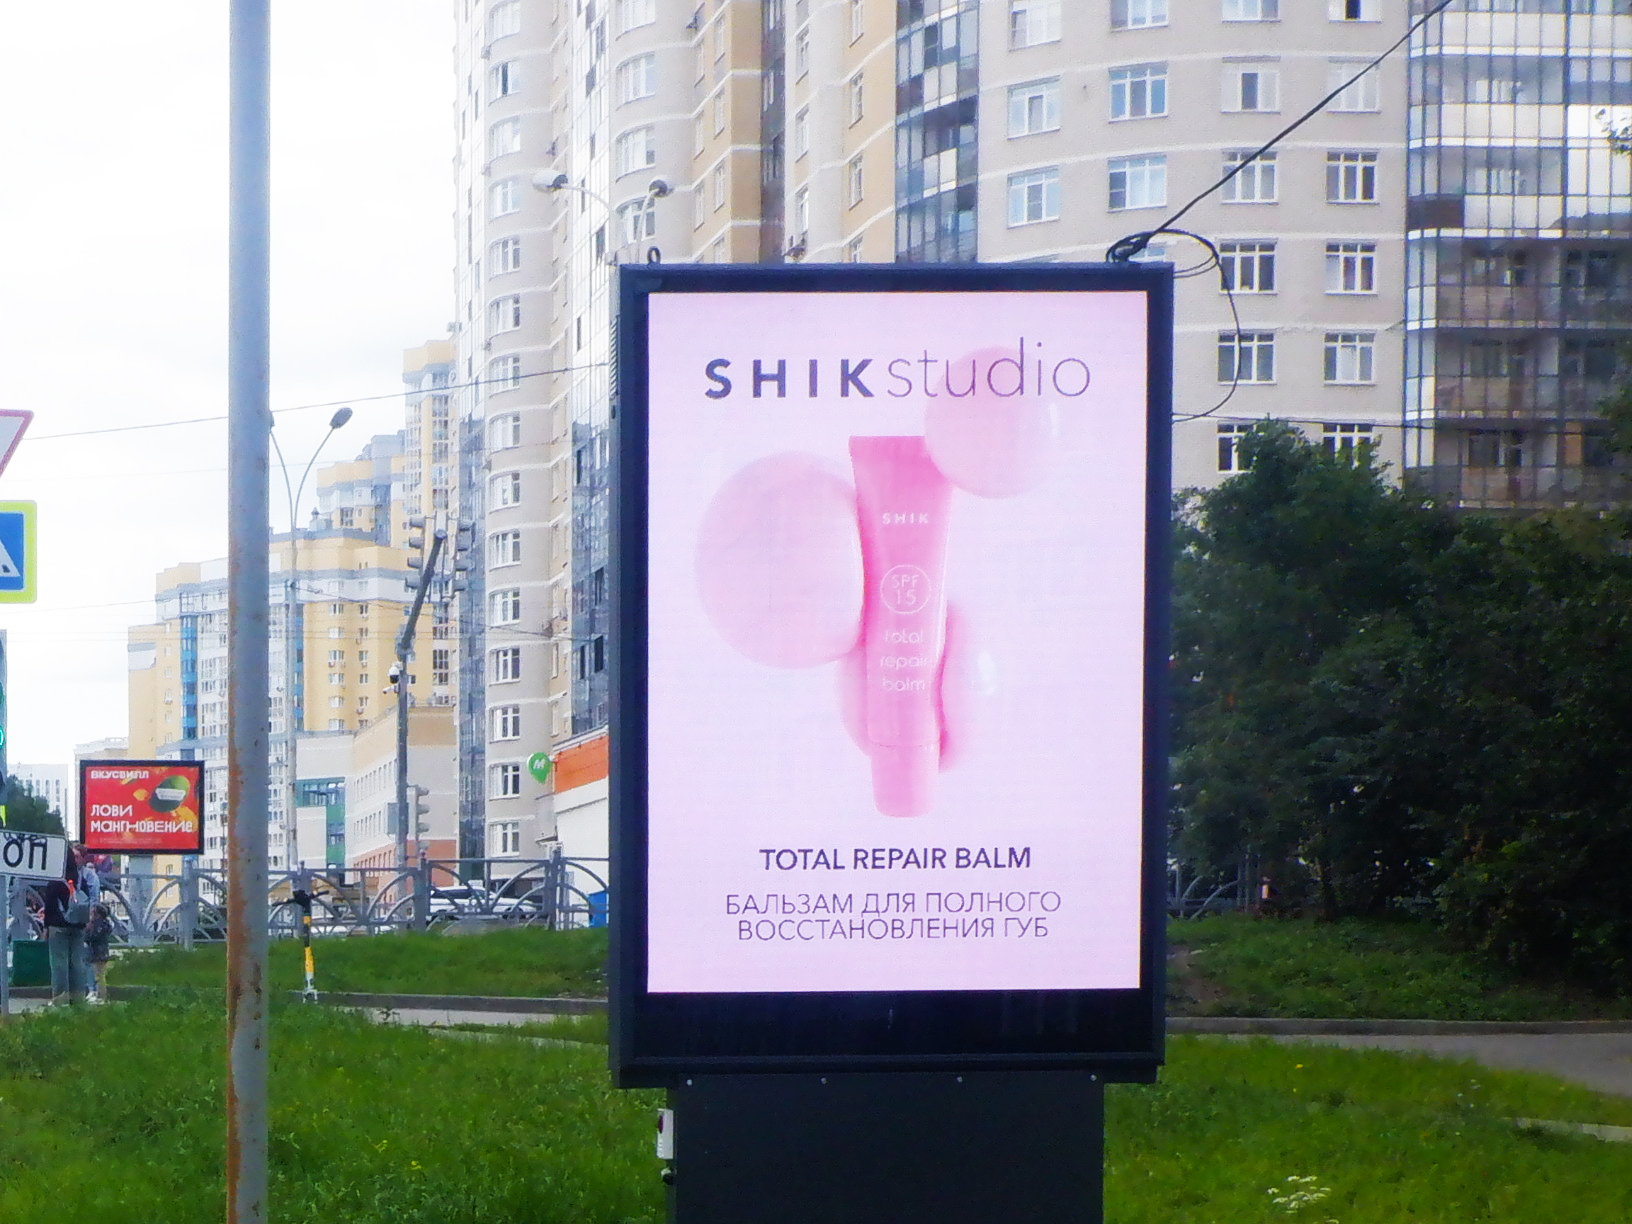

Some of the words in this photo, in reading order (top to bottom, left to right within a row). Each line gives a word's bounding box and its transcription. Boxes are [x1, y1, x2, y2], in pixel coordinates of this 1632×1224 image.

[881, 512, 929, 525] SHIK
[891, 574, 920, 589] SPF
[895, 589, 918, 605] 15
[90, 804, 133, 817] ЛОВИ
[759, 848, 846, 871] TOTAL
[853, 847, 947, 870] REPAIR
[955, 846, 1031, 869] BALM
[726, 893, 854, 915] БАЛЬЗАМ
[861, 892, 916, 918] ДЛЯ
[926, 890, 1062, 914] ПОЛНОГО
[738, 917, 995, 941] ВОССТАНОВЛЕНИЯ
[1004, 916, 1049, 939] ГУБ
